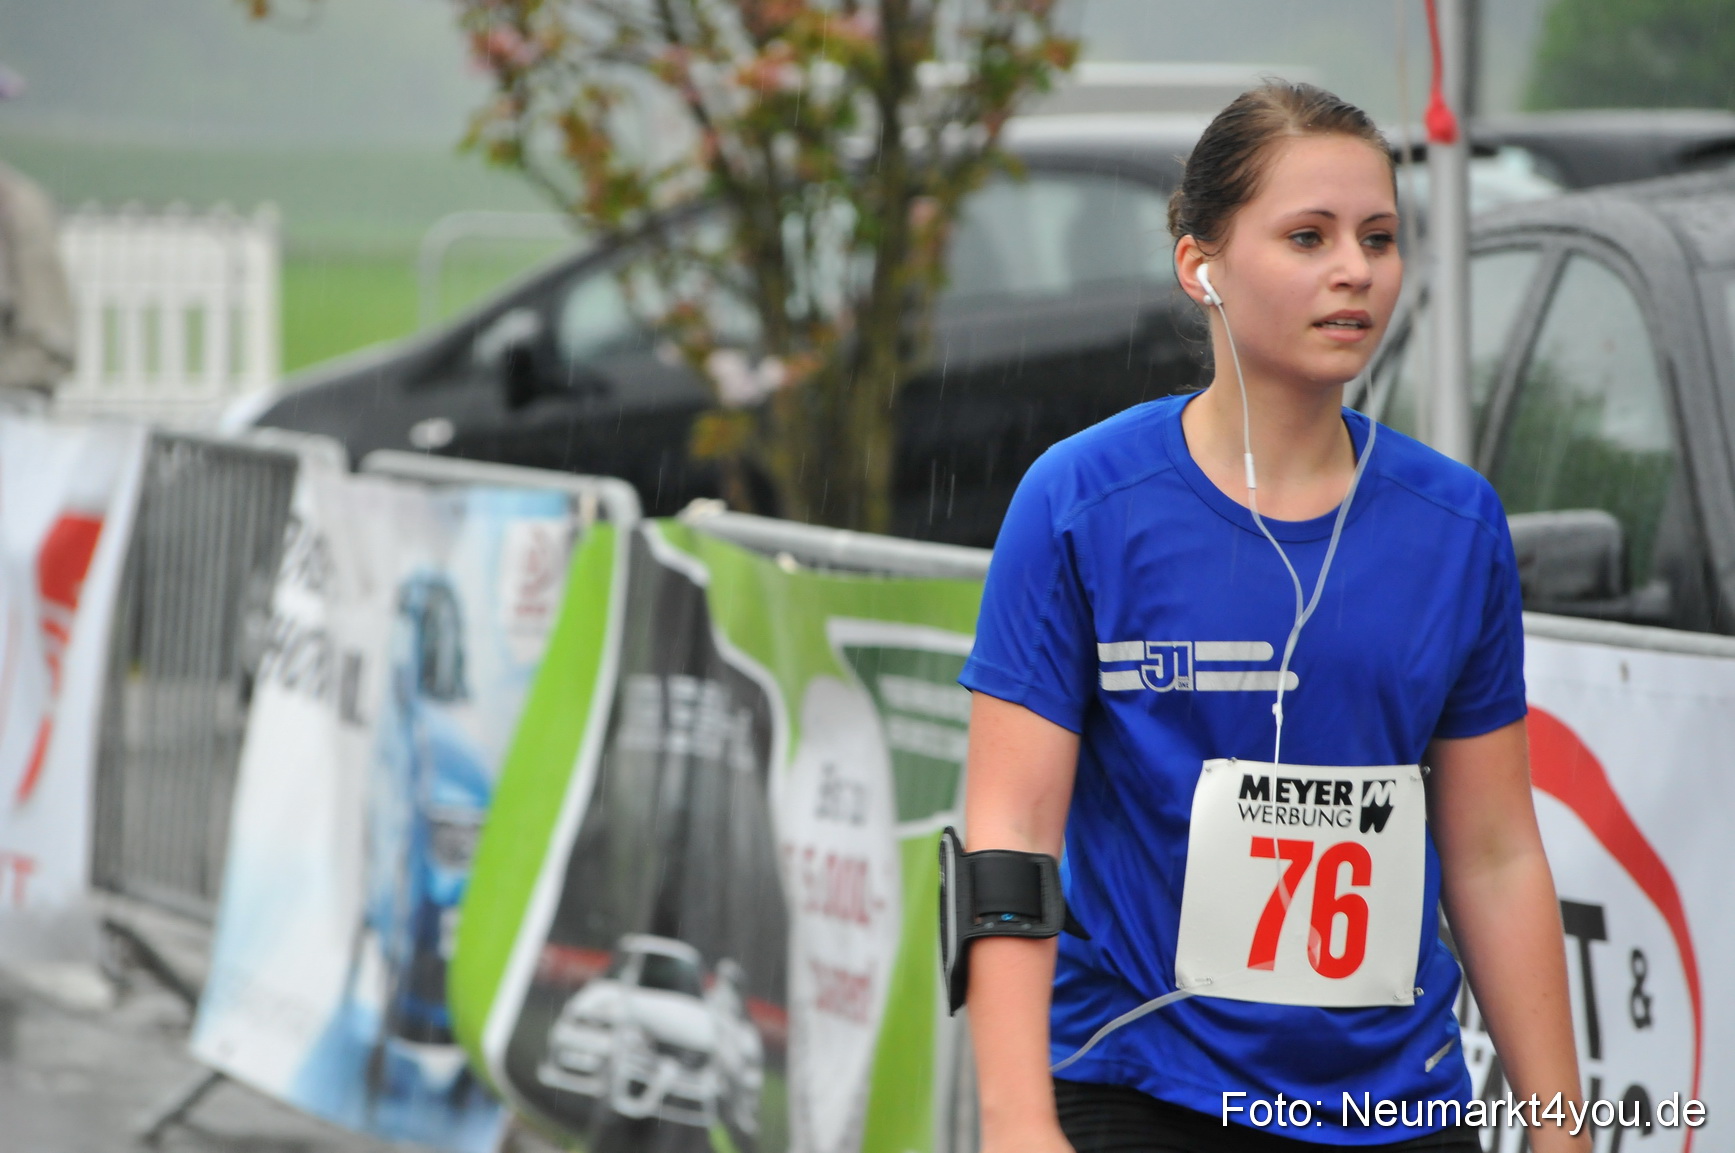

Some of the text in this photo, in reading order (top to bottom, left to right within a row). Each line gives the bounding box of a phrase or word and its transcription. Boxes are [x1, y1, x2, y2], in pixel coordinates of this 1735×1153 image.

[1238, 774, 1354, 806] MEYER
[1237, 802, 1353, 828] WERBUNG
[1246, 835, 1373, 980] 76
